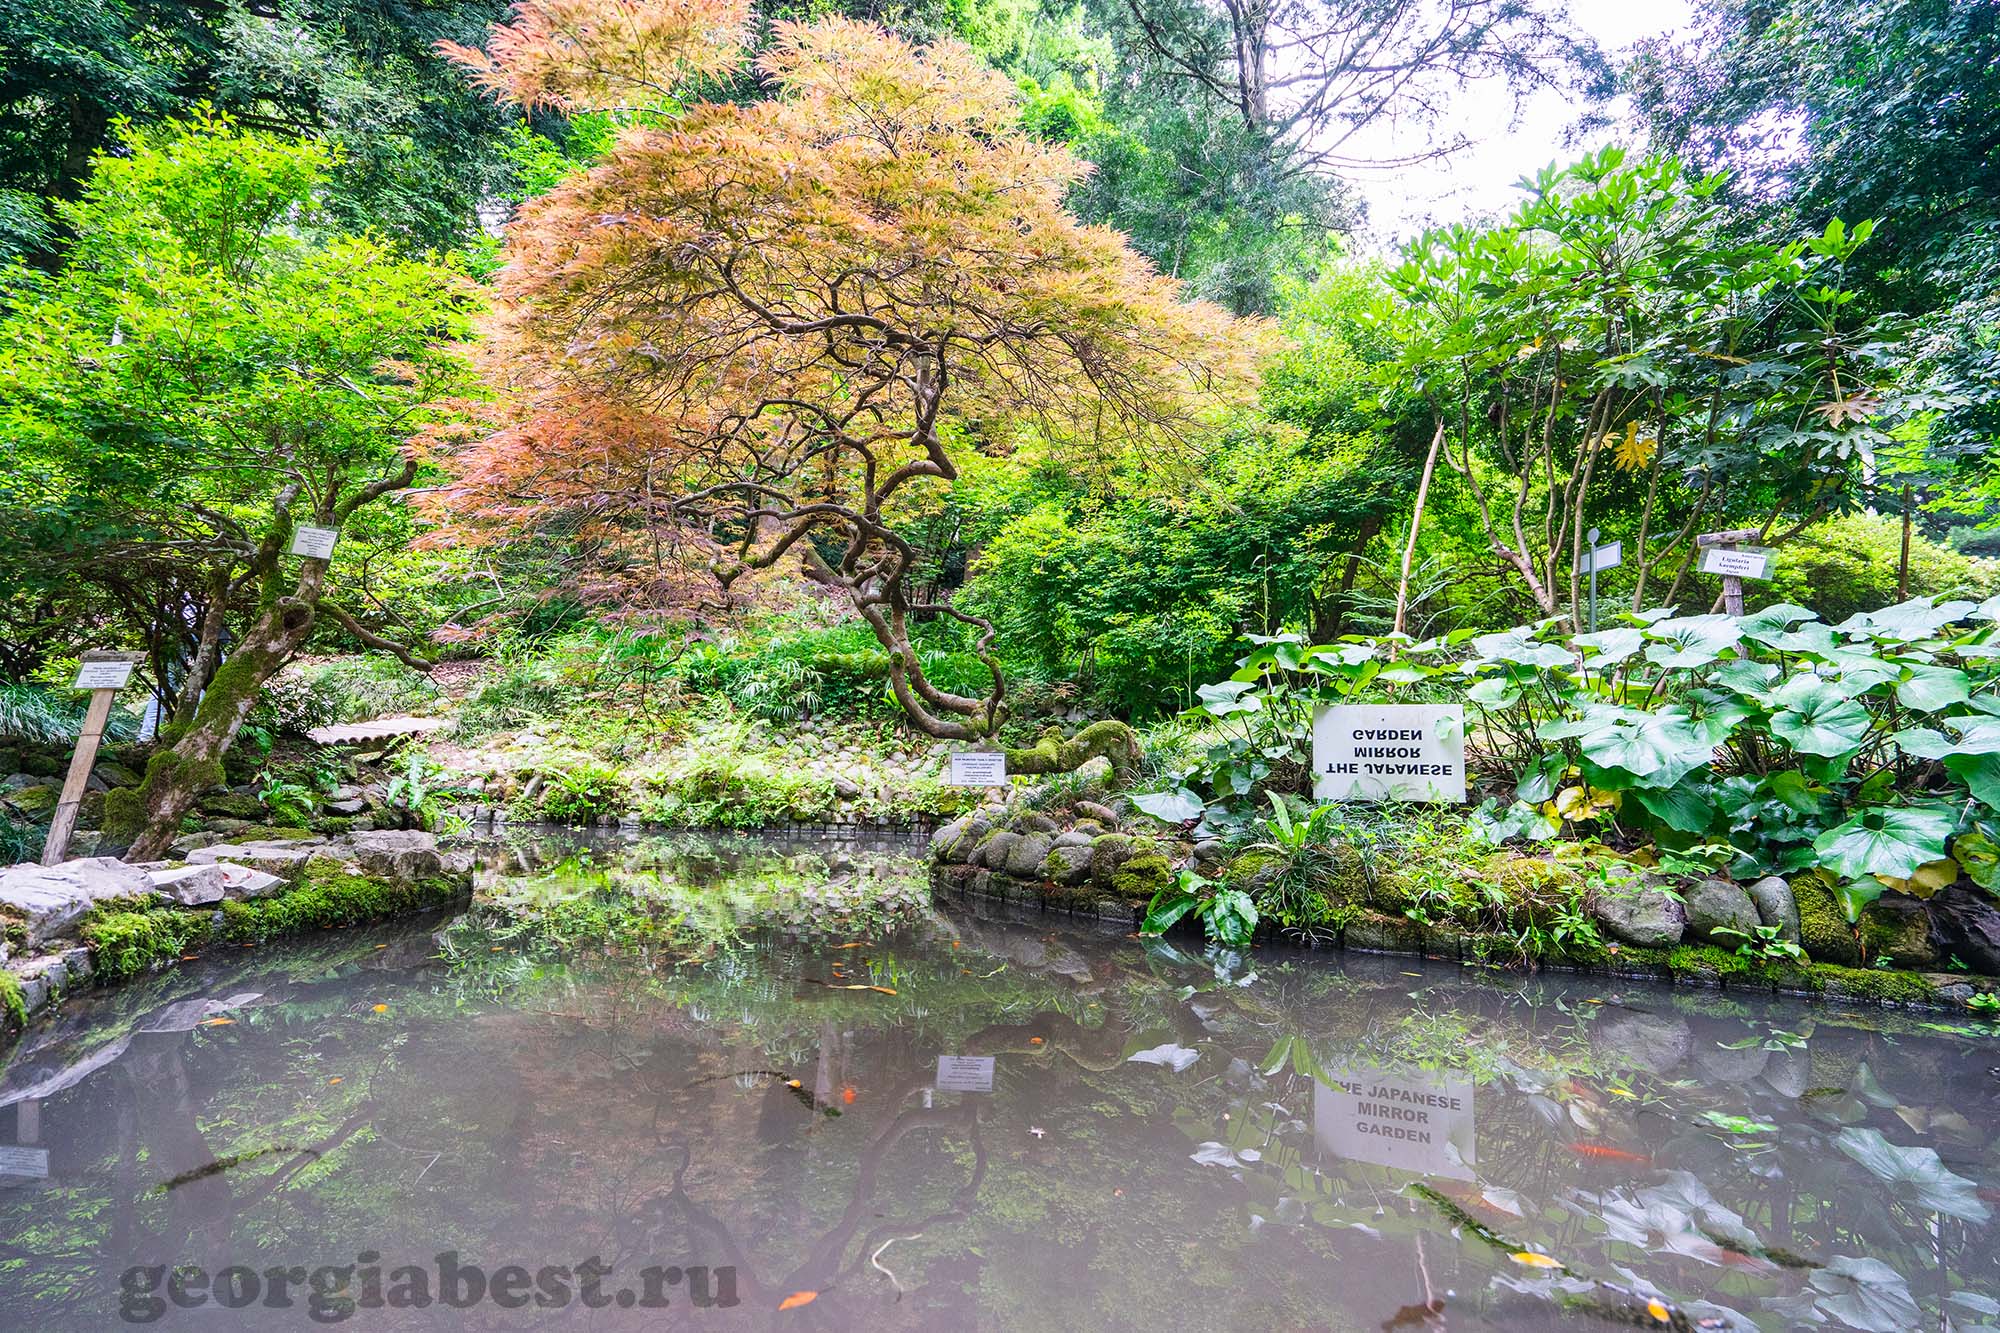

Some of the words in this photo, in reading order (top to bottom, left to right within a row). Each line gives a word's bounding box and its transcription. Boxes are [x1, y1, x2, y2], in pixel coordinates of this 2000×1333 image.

[1368, 1085, 1461, 1111] JAPANESE
[1358, 1101, 1429, 1125] MIRROR
[1356, 1121, 1431, 1145] GARDEN
